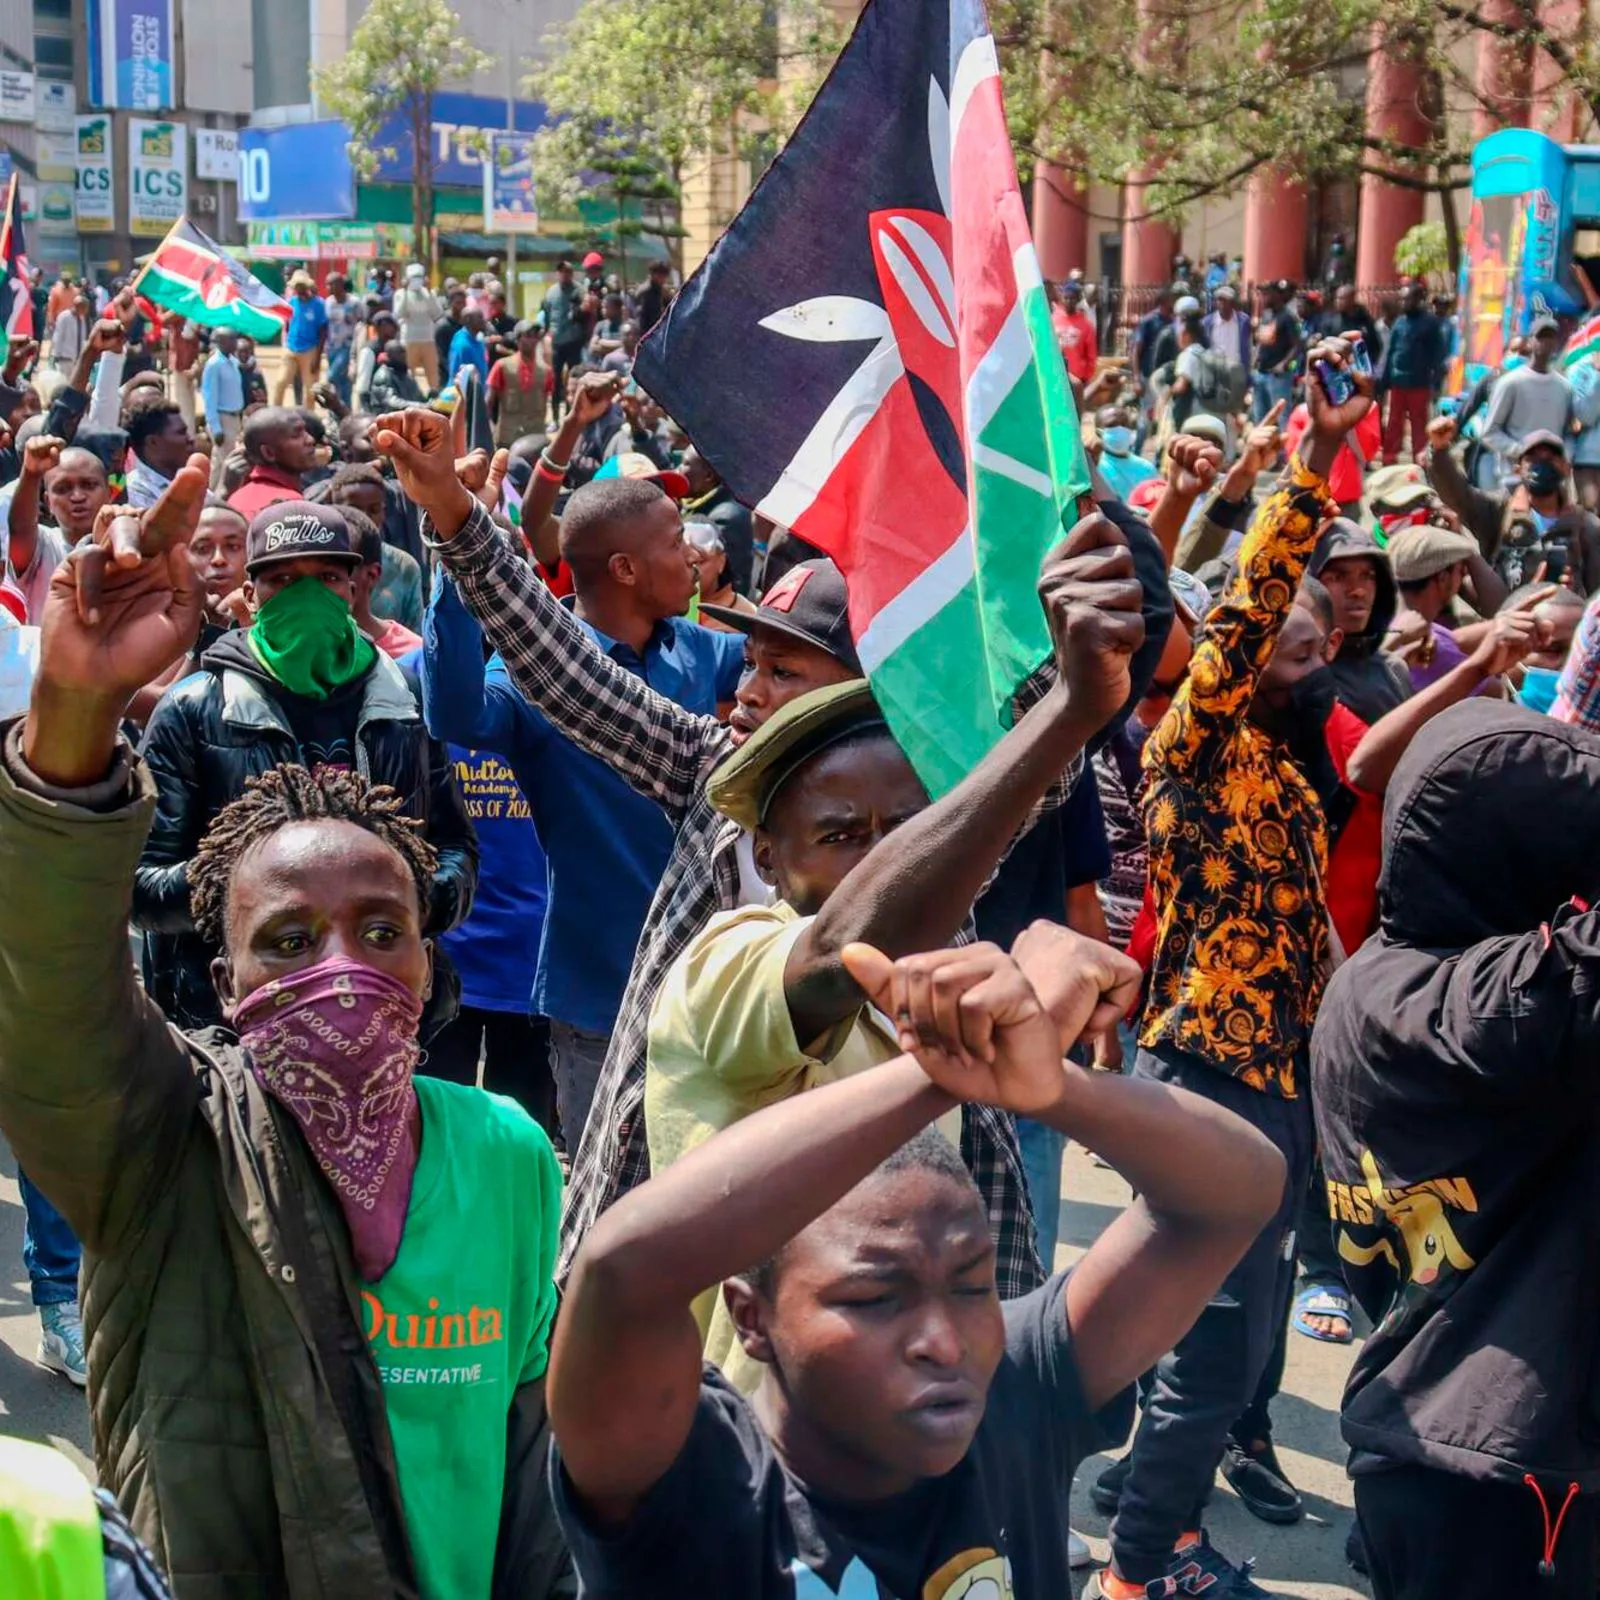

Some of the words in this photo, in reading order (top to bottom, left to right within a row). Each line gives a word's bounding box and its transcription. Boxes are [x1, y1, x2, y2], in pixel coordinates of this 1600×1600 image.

[74, 166, 110, 191] ICS
[133, 166, 183, 197] ICS
[265, 521, 336, 552] Bulls
[486, 799, 504, 818] OF
